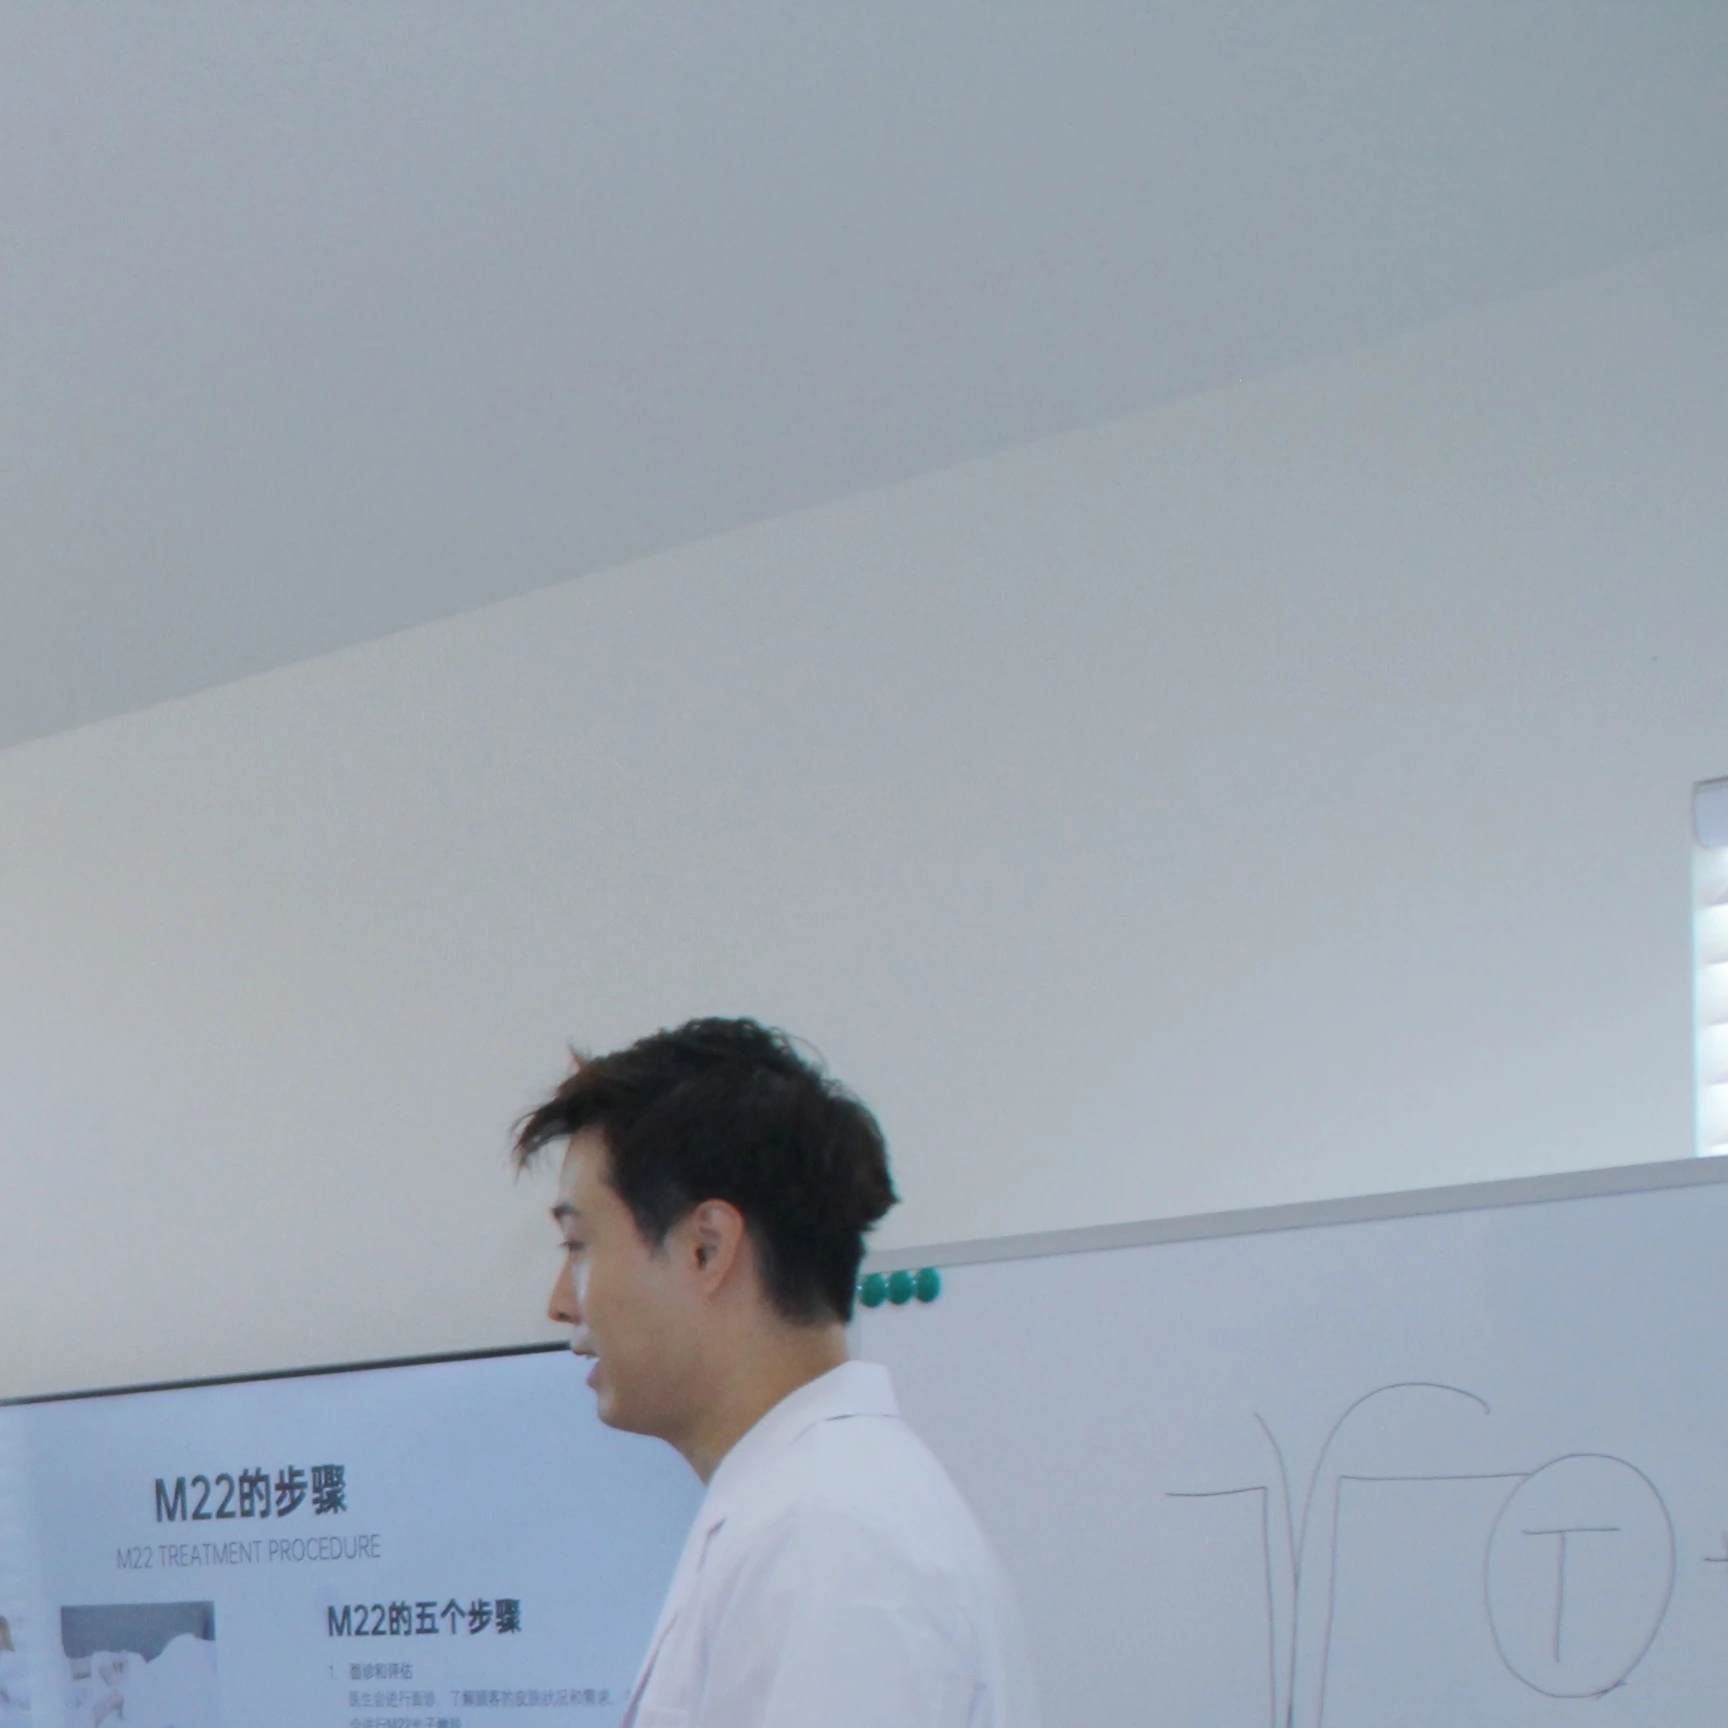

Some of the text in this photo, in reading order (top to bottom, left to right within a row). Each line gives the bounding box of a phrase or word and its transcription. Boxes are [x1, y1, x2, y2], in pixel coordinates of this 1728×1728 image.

[154, 1463, 348, 1523] M22的步骤
[115, 1533, 382, 1570] M22 TREATMENT PROCEDURE
[327, 1598, 522, 1638] M22的五个步骤
[1521, 1527, 1621, 1663] T
